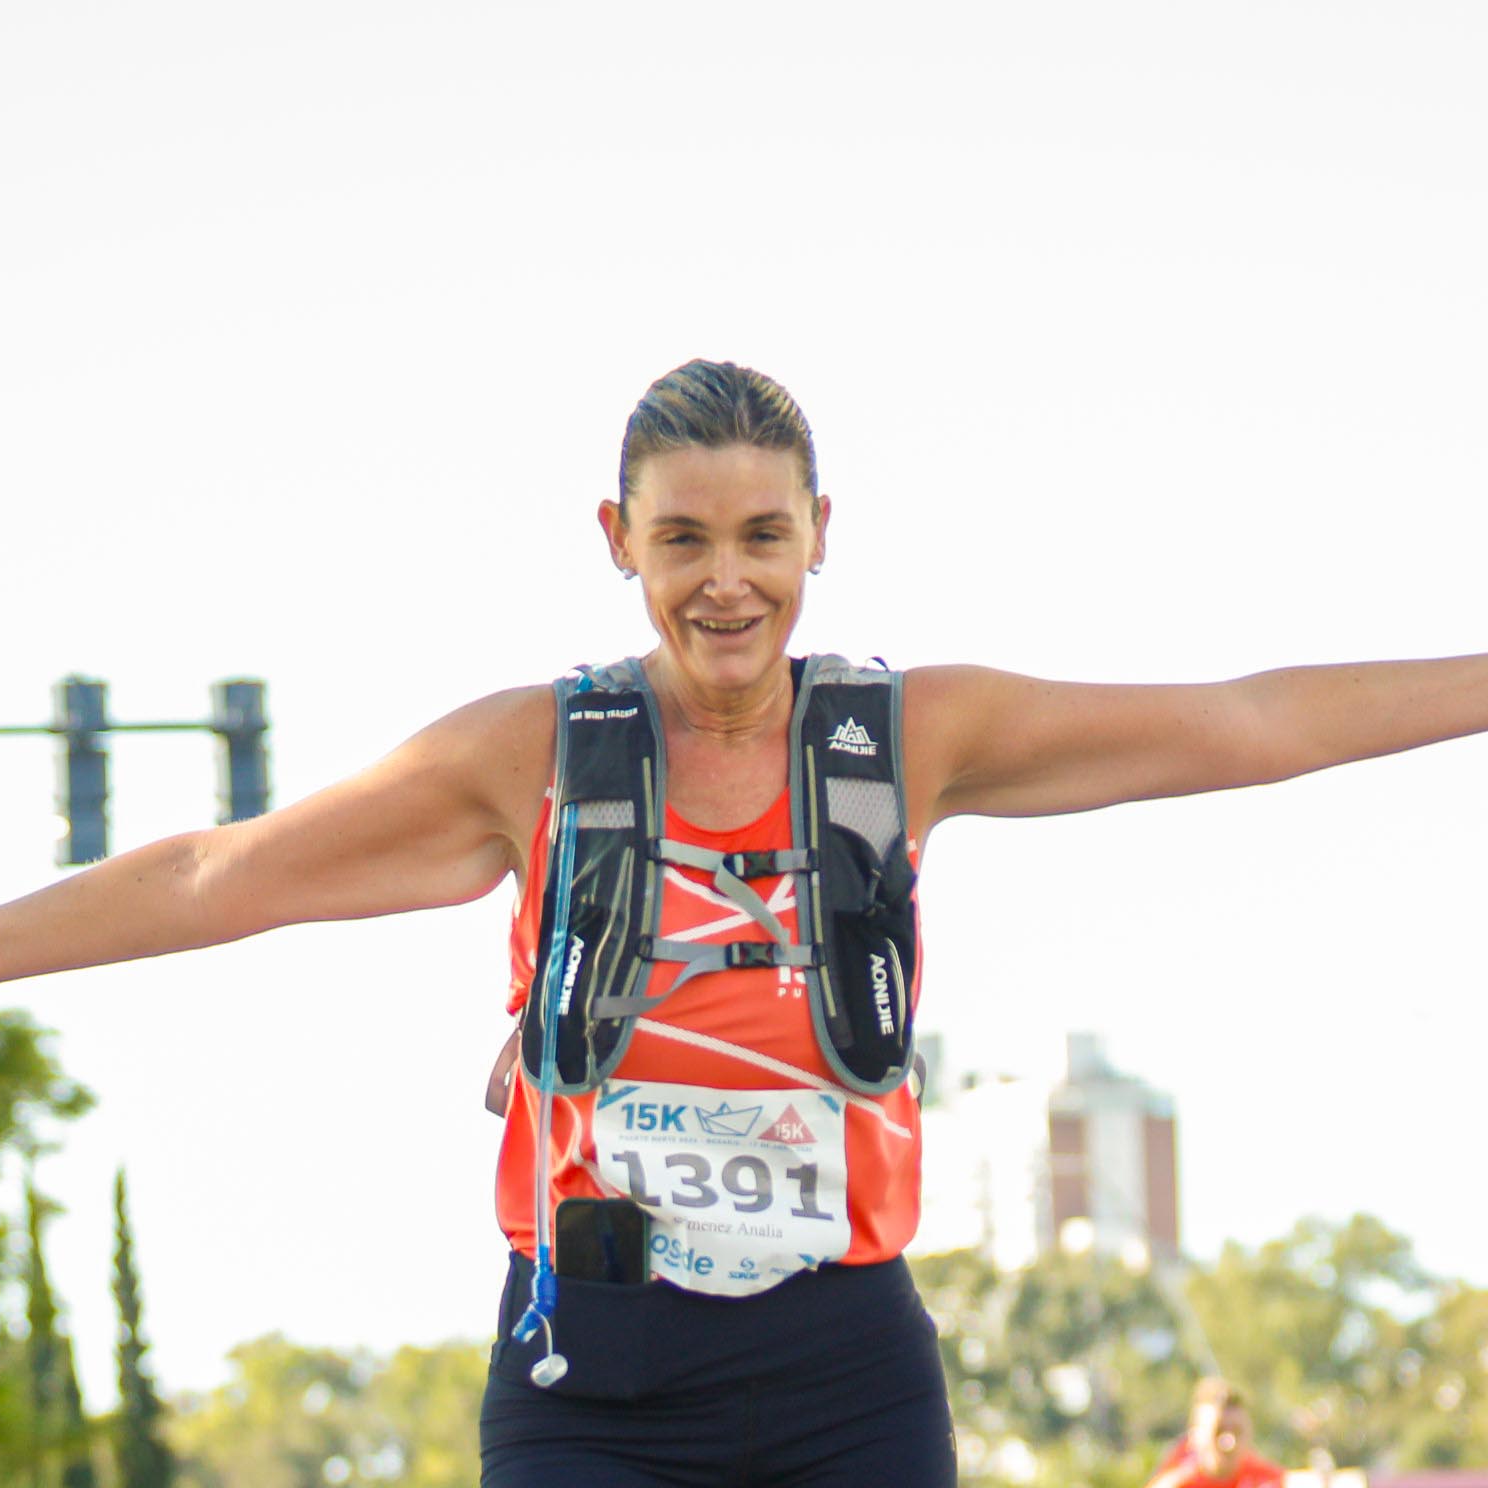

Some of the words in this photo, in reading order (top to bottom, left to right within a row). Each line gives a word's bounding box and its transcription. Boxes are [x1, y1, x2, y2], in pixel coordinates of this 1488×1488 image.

[869, 952, 895, 1035] AONIJIE
[621, 1102, 688, 1132] 15K
[774, 1122, 804, 1140] 15K
[612, 1150, 835, 1222] 1391
